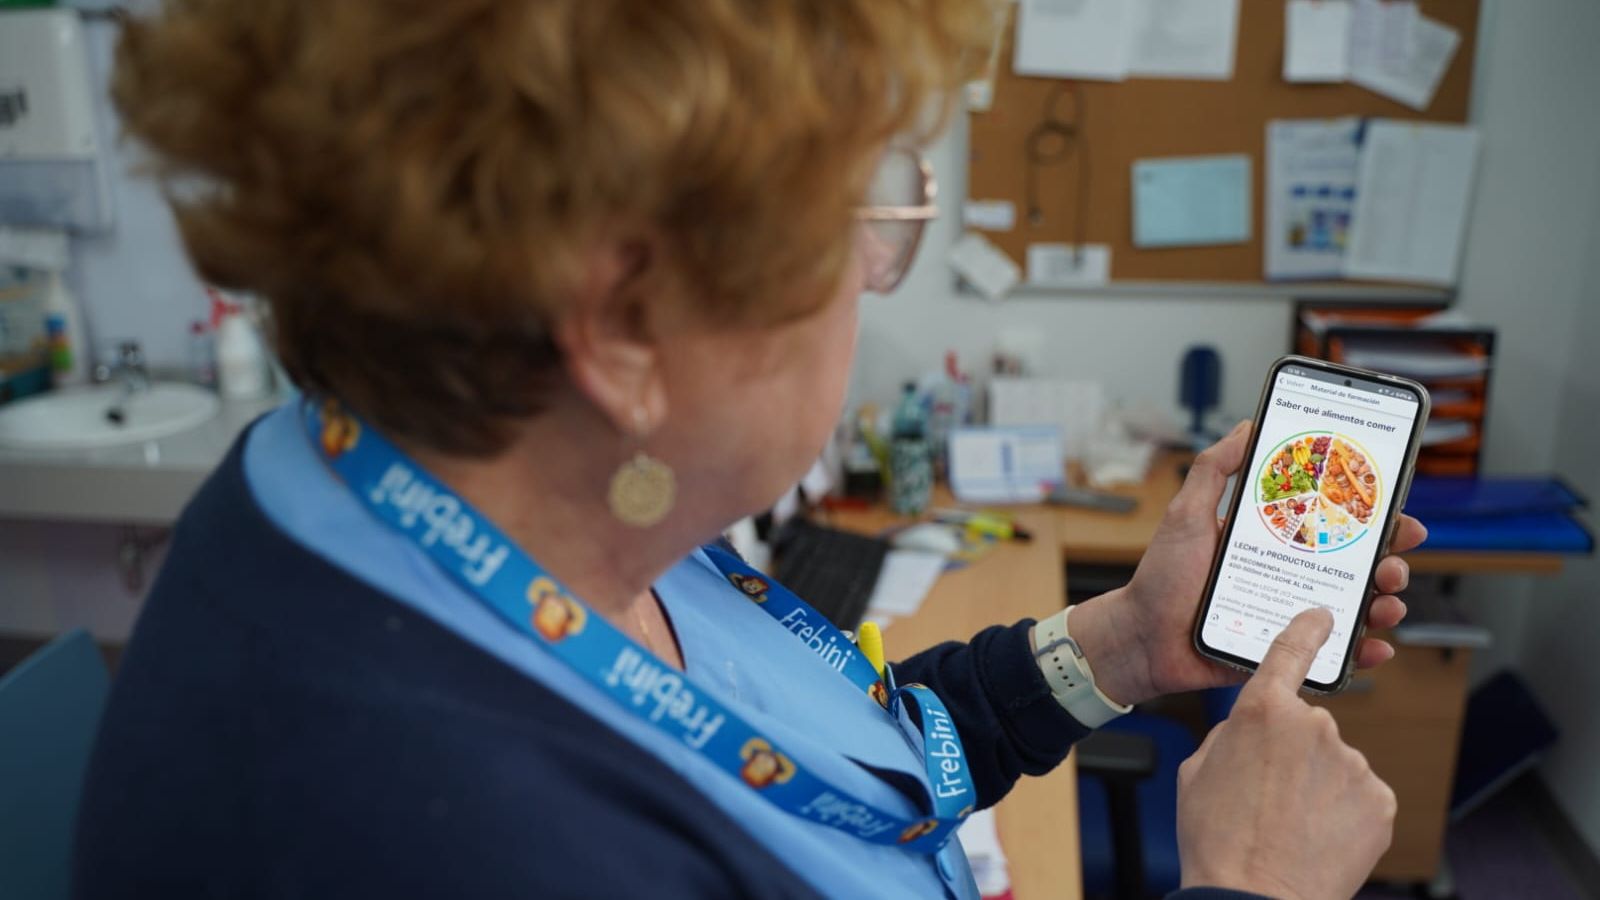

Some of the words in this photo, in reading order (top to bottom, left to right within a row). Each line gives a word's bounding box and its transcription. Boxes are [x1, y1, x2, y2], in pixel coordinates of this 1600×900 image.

[1311, 384, 1338, 396] Material
[1347, 393, 1380, 405] formación
[1275, 397, 1302, 411] Saber
[1321, 408, 1365, 427] alimentos
[1366, 420, 1397, 433] comer
[370, 461, 510, 586] Frebini
[1234, 541, 1258, 554] LECHE
[1266, 549, 1316, 571] PRODUCTOS
[1240, 556, 1281, 573] RECOMIENDA
[1259, 584, 1279, 595] LECHE
[1271, 574, 1292, 585] LECHE
[1293, 580, 1301, 588] AL
[1271, 596, 1295, 607] QUESO
[780, 607, 853, 672] Frebini
[605, 646, 726, 749] Frebini
[927, 708, 968, 798] Frebini
